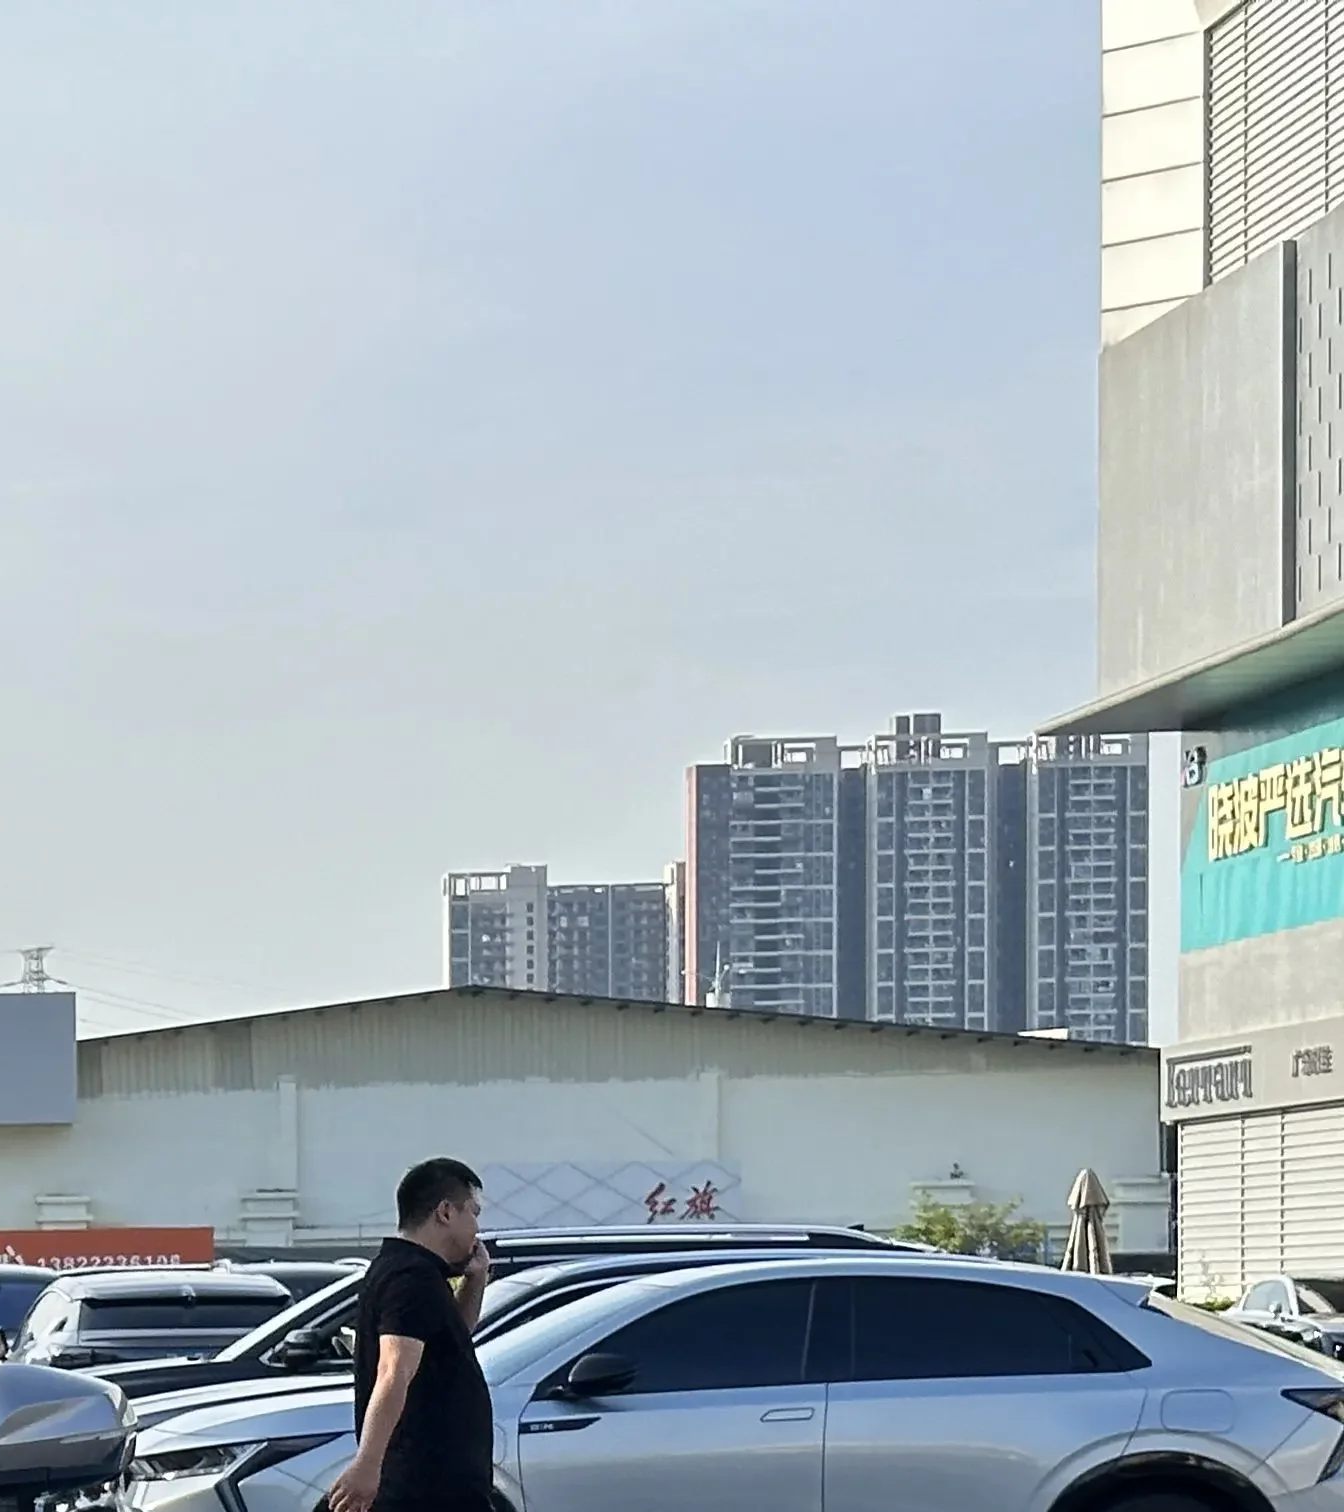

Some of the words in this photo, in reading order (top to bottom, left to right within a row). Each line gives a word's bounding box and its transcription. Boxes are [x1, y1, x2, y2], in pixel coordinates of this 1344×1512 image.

[1207, 747, 1344, 863] 晓波严选汽
[643, 1180, 719, 1224] 红旗
